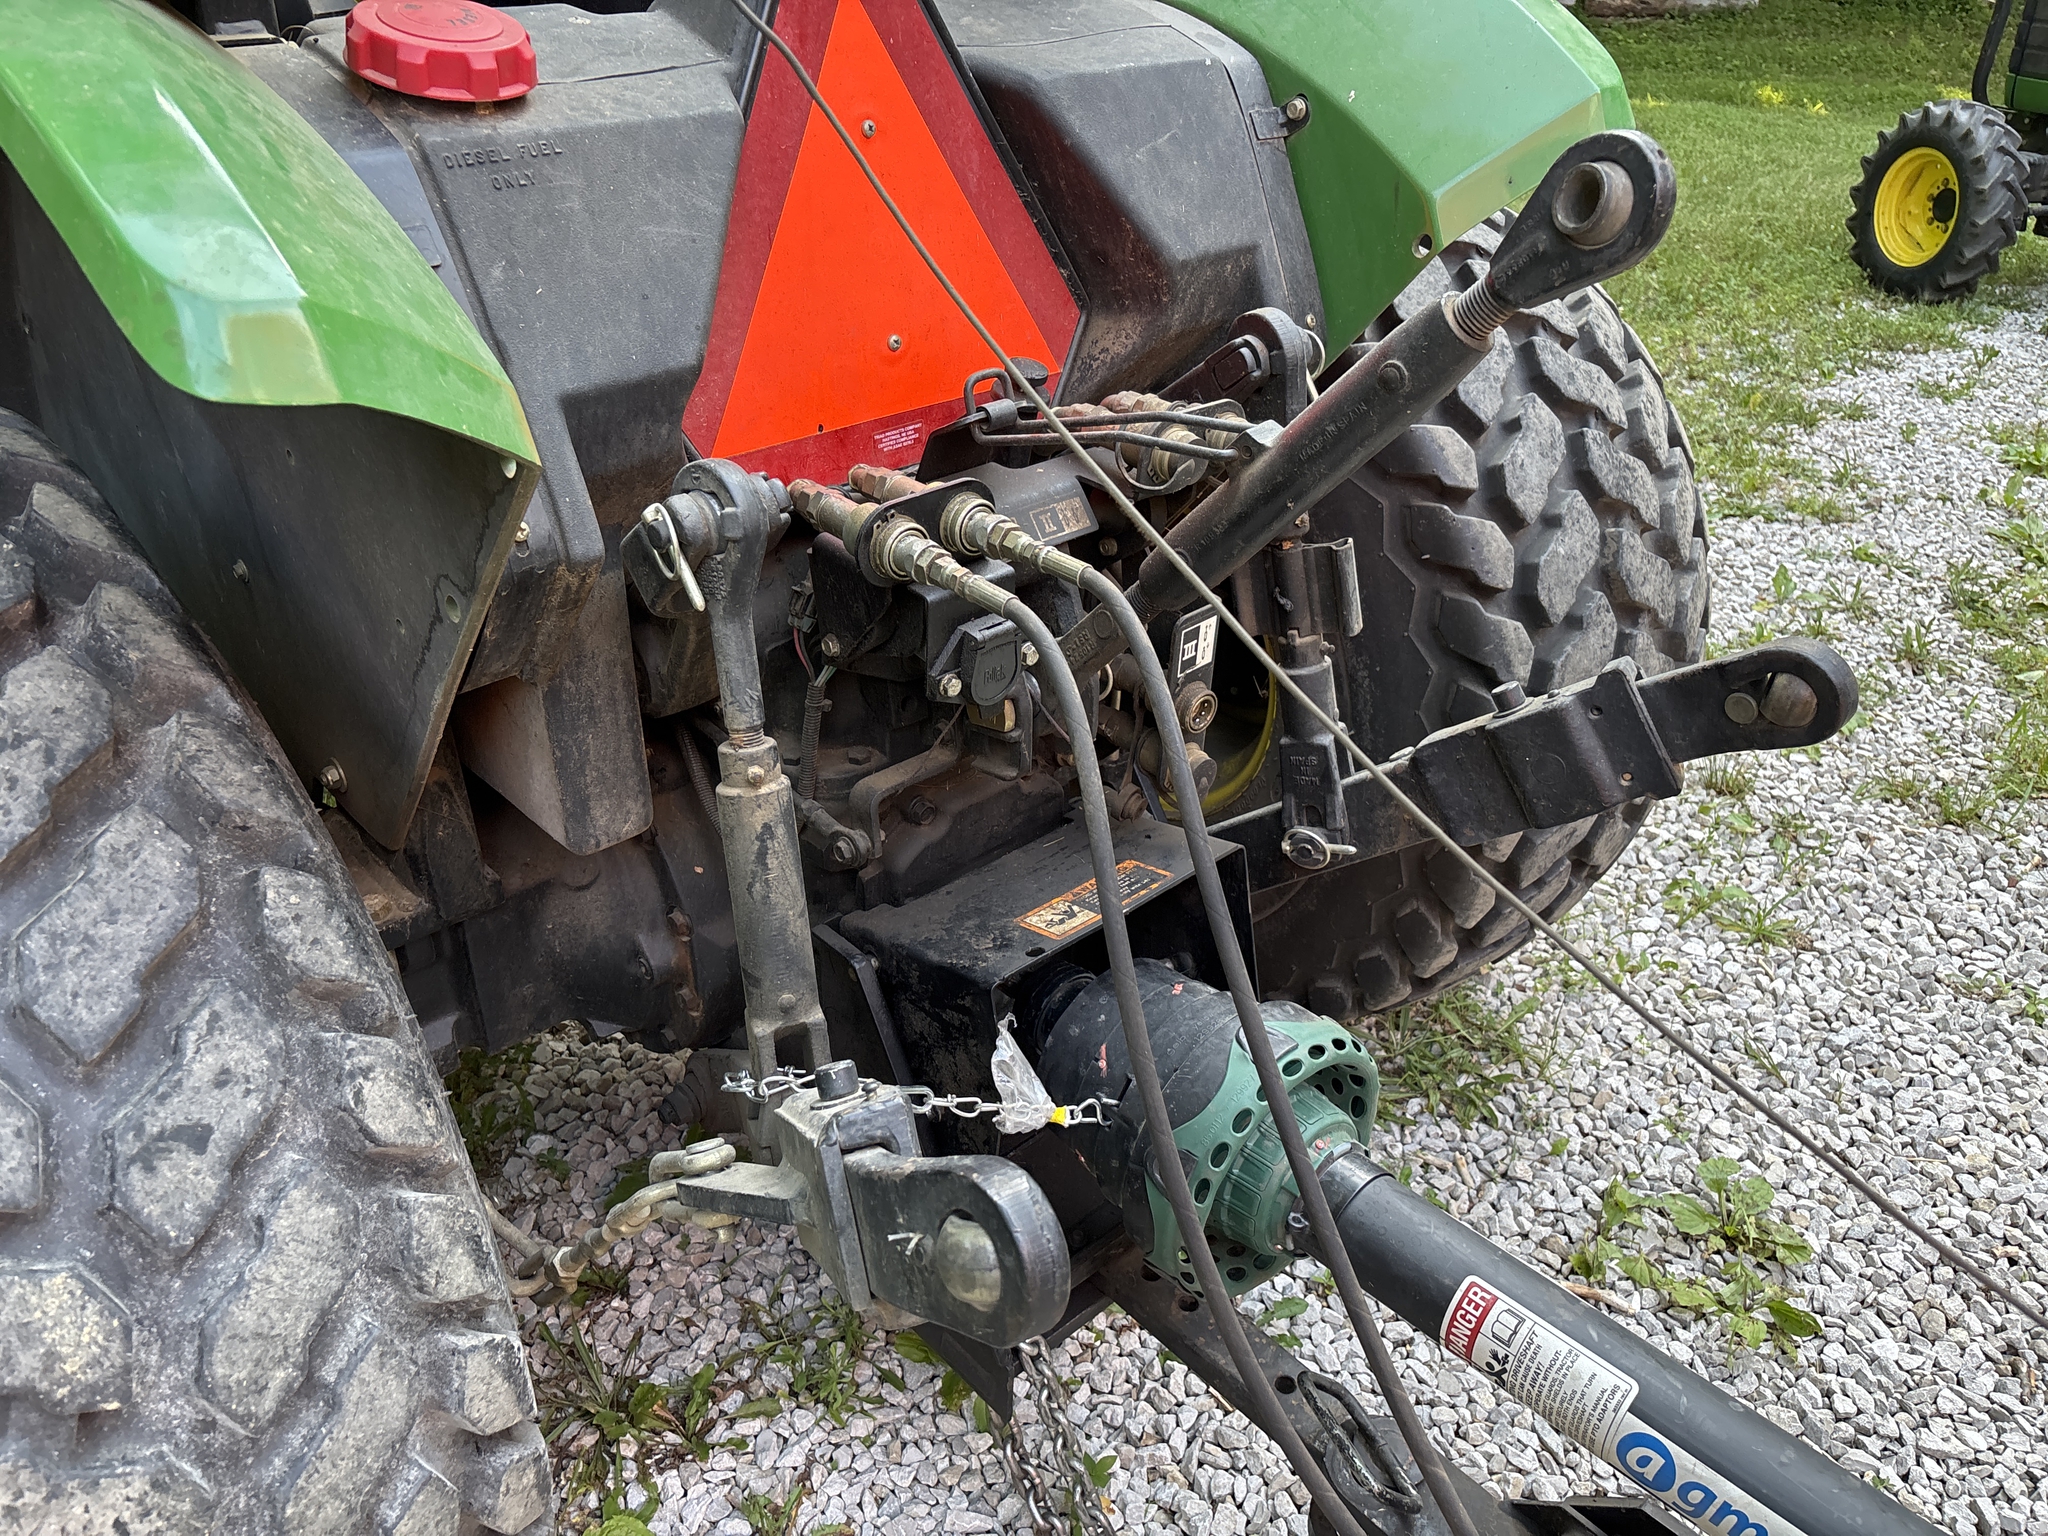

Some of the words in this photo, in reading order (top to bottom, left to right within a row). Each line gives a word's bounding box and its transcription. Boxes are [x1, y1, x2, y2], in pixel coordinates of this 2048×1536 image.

[442, 148, 511, 169] DIESEL
[517, 140, 563, 159] FUEL
[491, 170, 536, 190] ONLY
[1509, 1328, 1540, 1382] DRIVESHAFT
[1519, 1362, 1533, 1383] CAUSE
[1527, 1343, 1543, 1365] DEATH
[1526, 1360, 1546, 1391] AWAY!
[1531, 1380, 1547, 1408] OPERATE
[1540, 1347, 1564, 1383] WITHOUT-
[1543, 1374, 1560, 1402] GUARDS,
[1554, 1347, 1574, 1376] TRACTOR
[1550, 1378, 1566, 1404] SHIELDS
[1564, 1351, 1581, 1373] PLACE
[1554, 1389, 1570, 1419] SECURELY
[1565, 1387, 1578, 1406] ENDS
[1567, 1403, 1581, 1427] GUARDS
[1576, 1387, 1588, 1405] THAT
[1583, 1370, 1598, 1390] TURN
[1590, 1385, 1608, 1413] MANUAL
[1594, 1382, 1621, 1425] ADAPTORS
[1573, 1401, 1590, 1435] DRIVESHAFT
[1589, 1421, 1600, 1437] PTO
